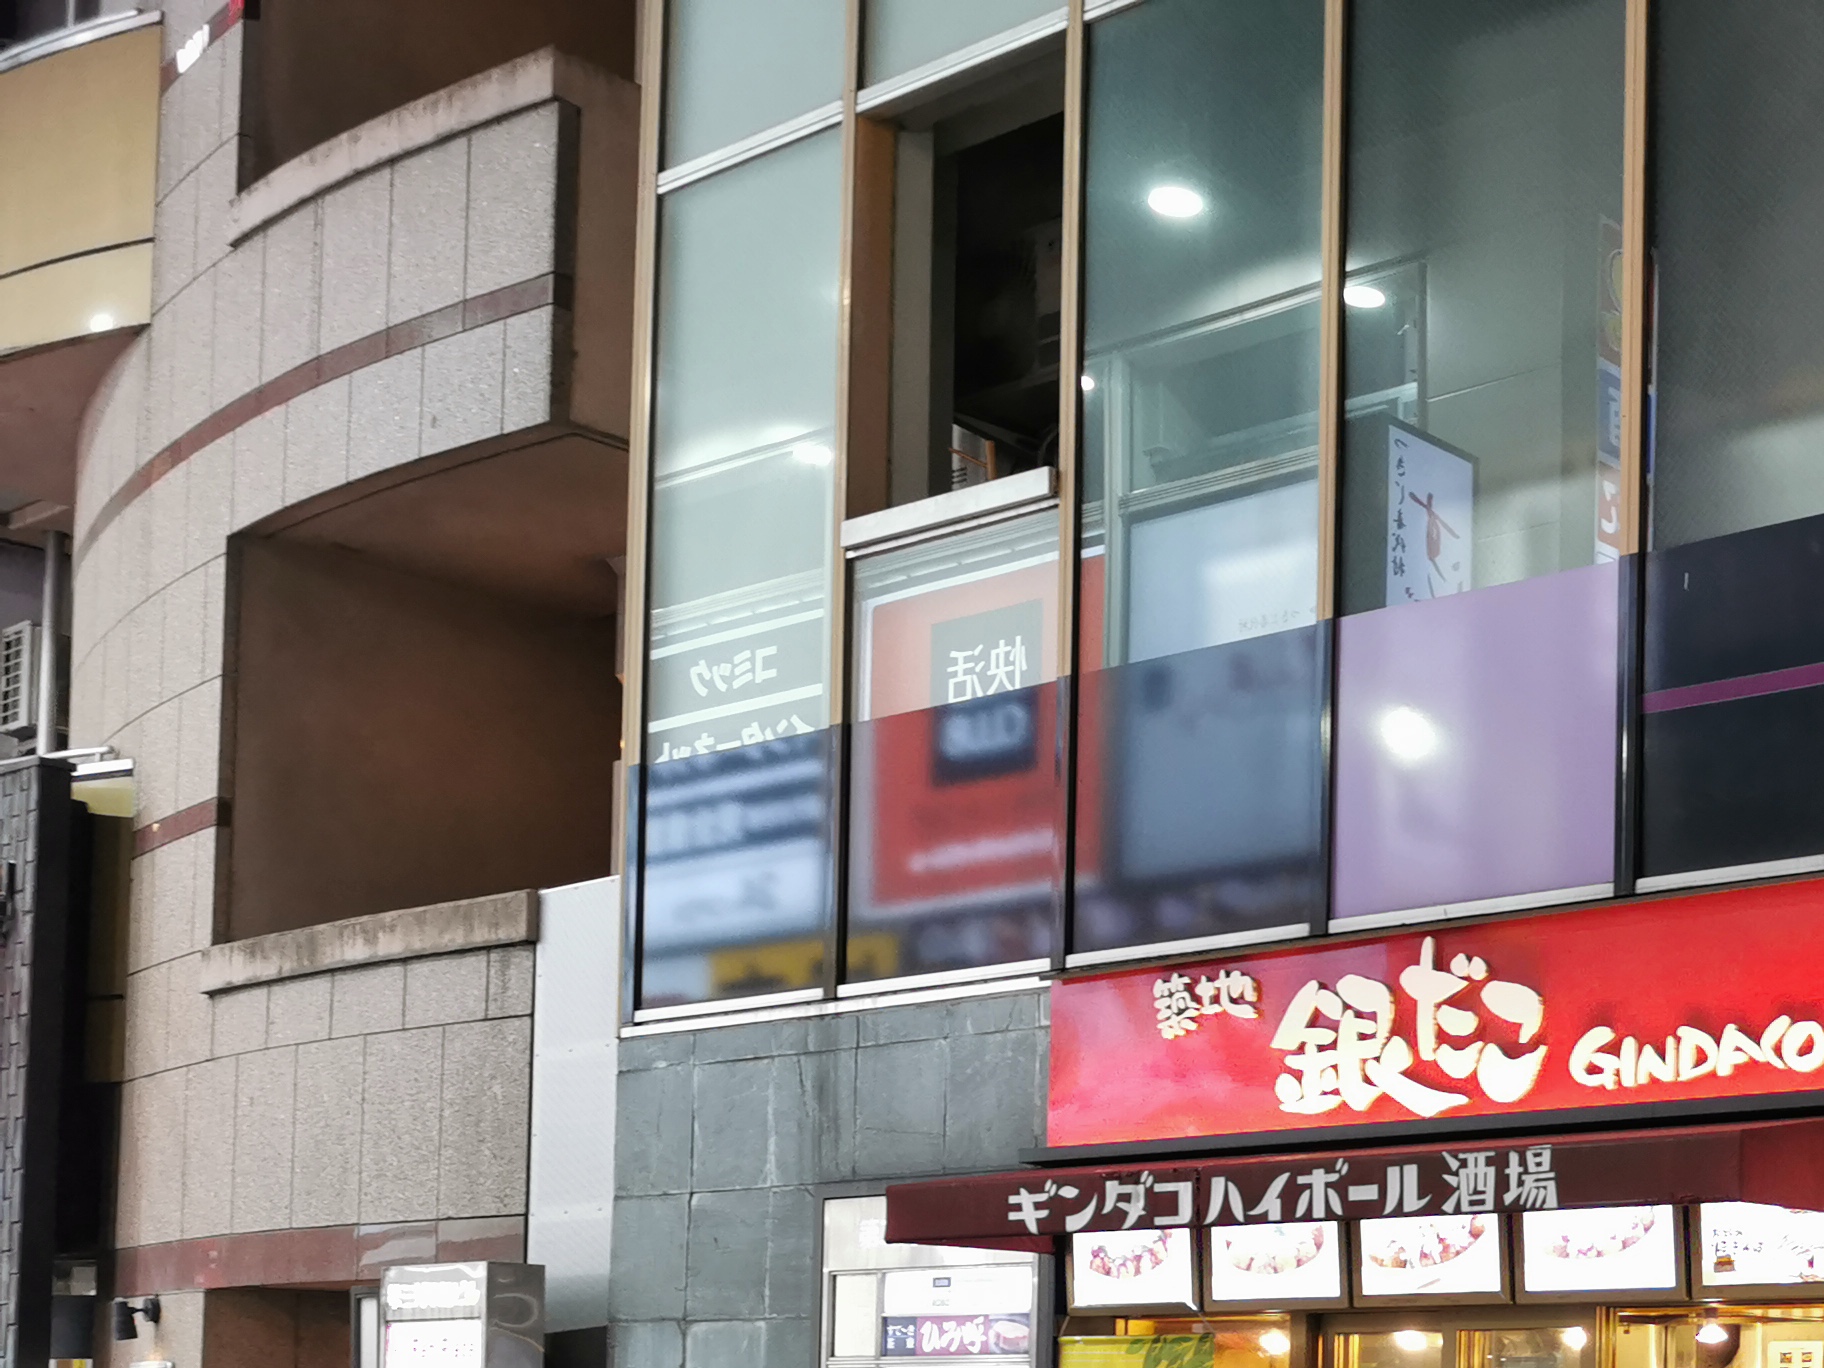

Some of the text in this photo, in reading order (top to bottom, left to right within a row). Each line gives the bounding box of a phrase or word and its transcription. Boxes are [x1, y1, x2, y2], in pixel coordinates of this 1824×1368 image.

[1153, 970, 1261, 1039] 築地
[1270, 936, 1548, 1118] 銀だこ
[1006, 1145, 1559, 1236] ギンダコハイボール酒場
